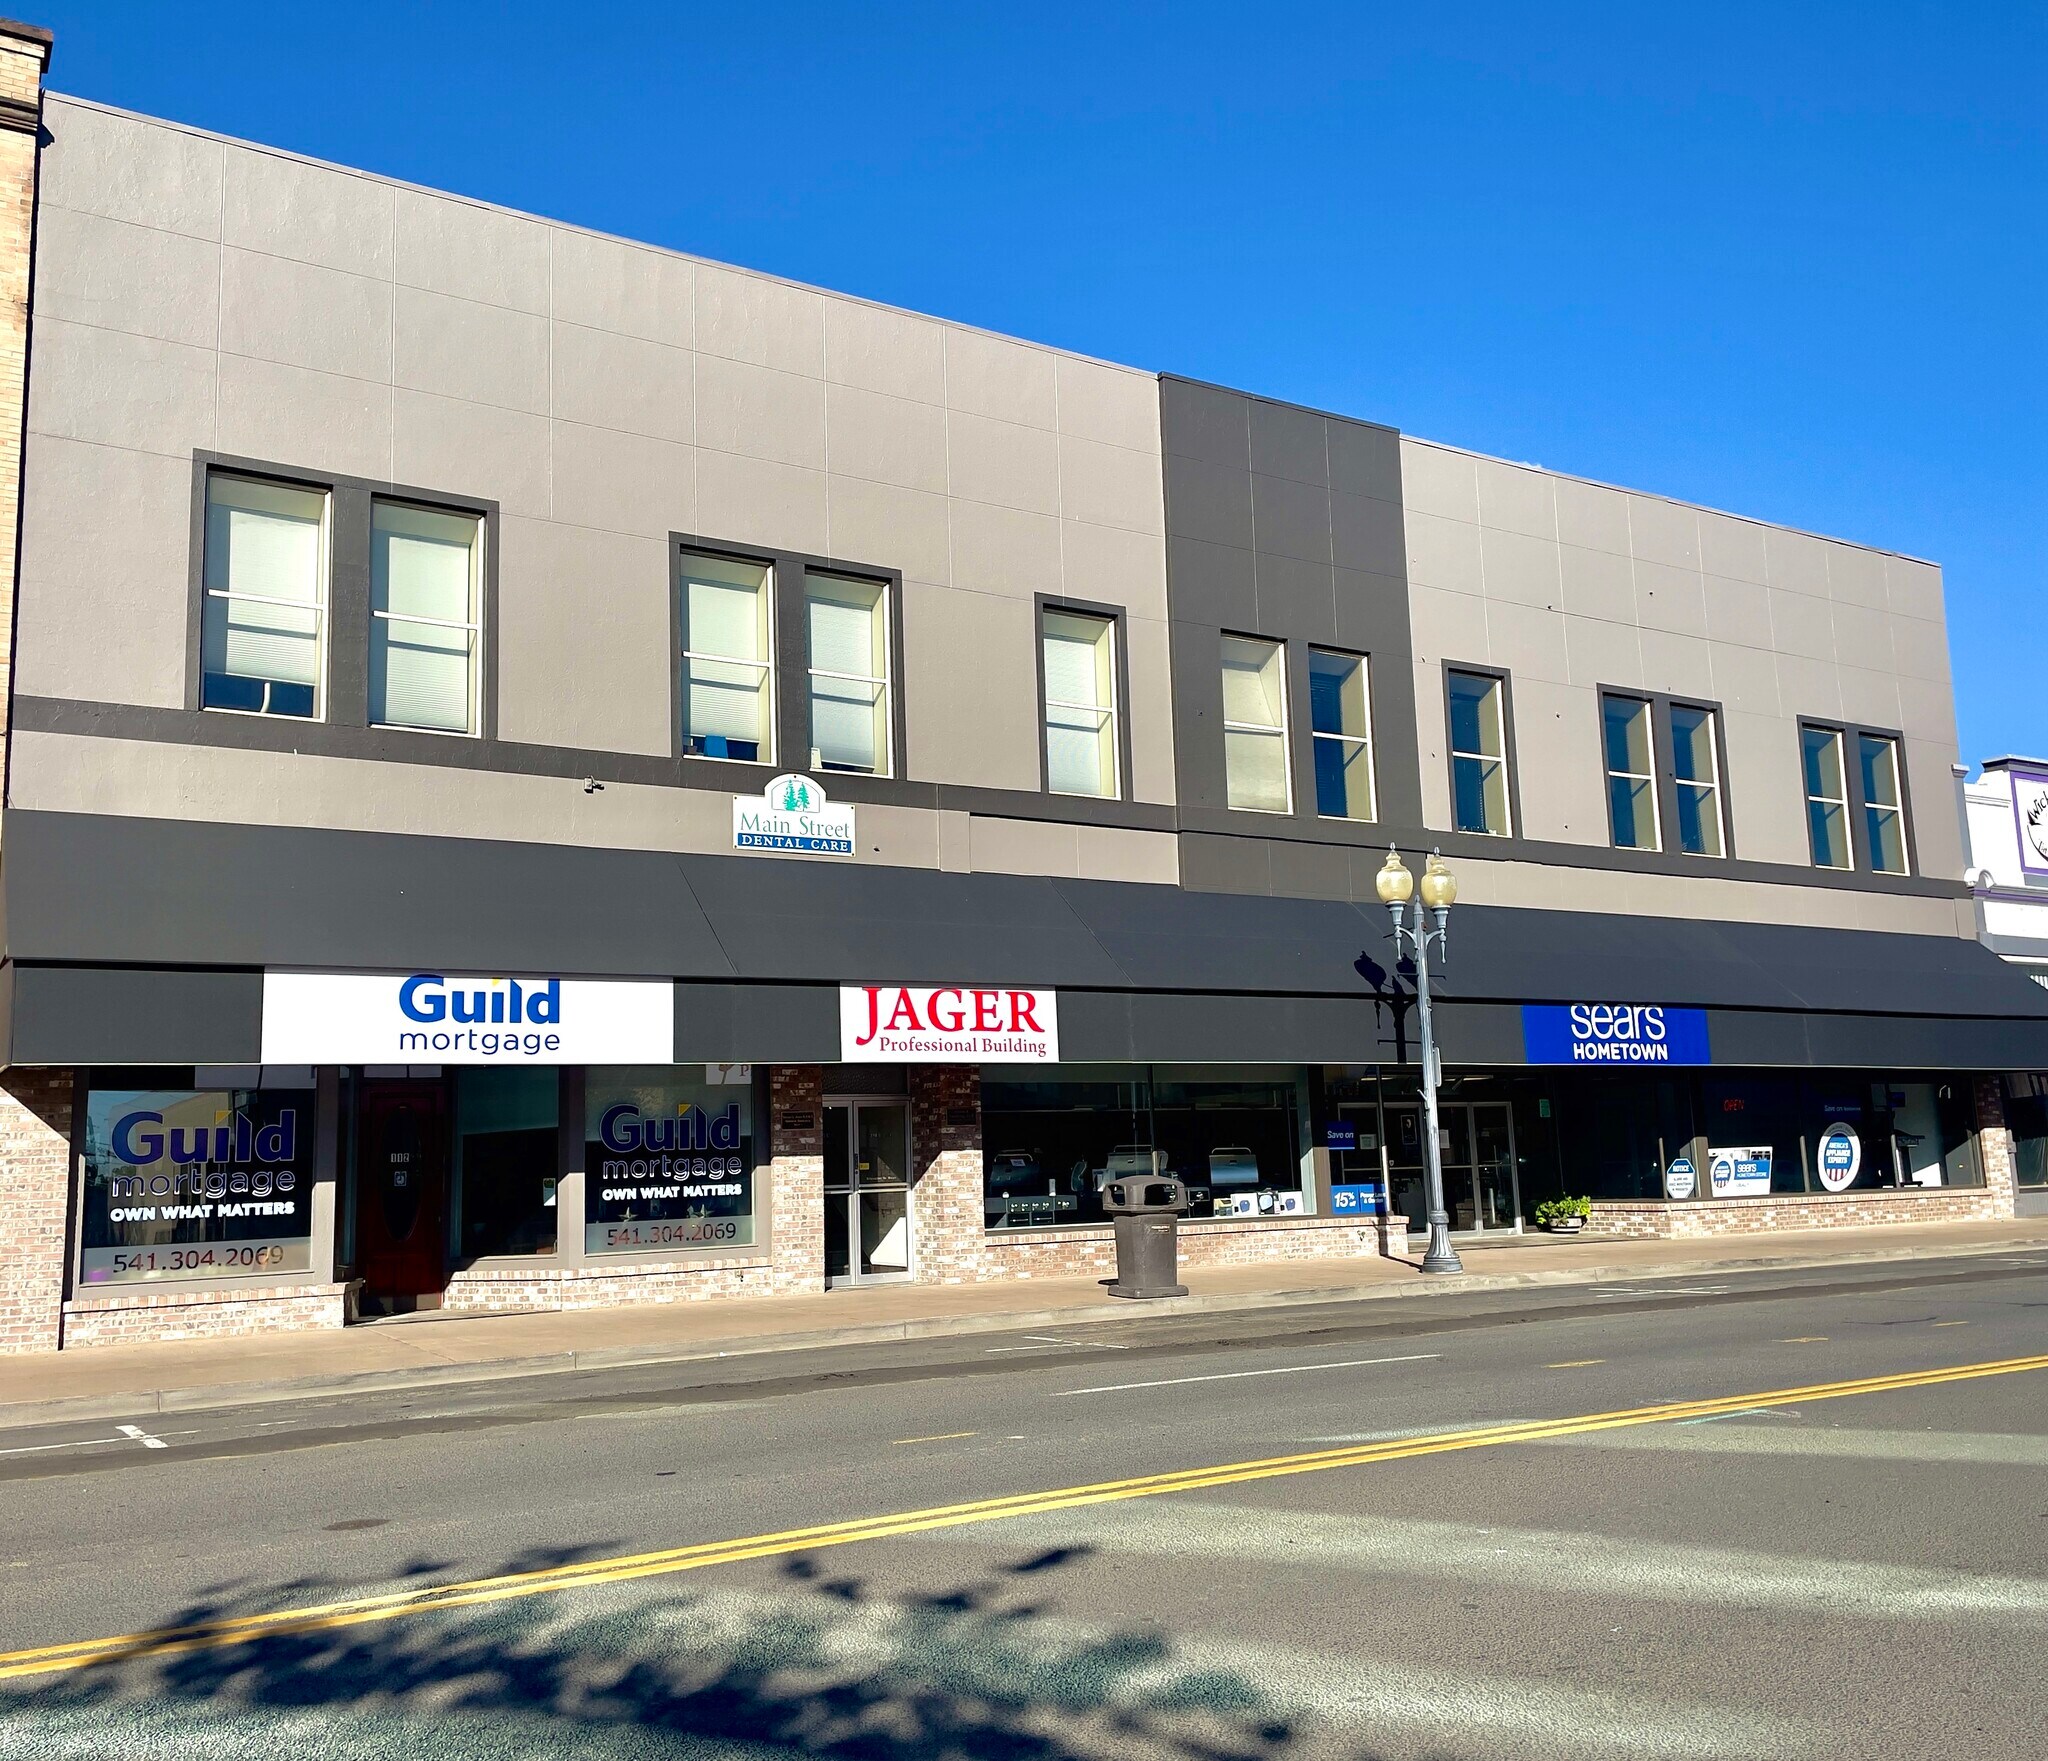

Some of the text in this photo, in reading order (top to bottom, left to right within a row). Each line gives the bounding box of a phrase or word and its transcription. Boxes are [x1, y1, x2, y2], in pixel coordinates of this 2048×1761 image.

[740, 812, 850, 839] Main Street
[741, 834, 848, 852] DENTAL CARE
[399, 974, 560, 1025] Guild
[856, 986, 1046, 1046] JAGER
[1570, 1003, 1666, 1040] sears
[400, 1028, 561, 1055] mortgage
[879, 1036, 1047, 1057] Professional Building
[1573, 1042, 1669, 1061] HOMETOWN
[111, 1109, 296, 1165] Guild
[600, 1103, 741, 1152] Guild
[1327, 1130, 1344, 1139] Save
[602, 1155, 742, 1181] mortgage
[1737, 1163, 1757, 1173] sears
[111, 1169, 296, 1199] mortgage
[602, 1183, 743, 1201] OWN WHAT MATTERS
[110, 1201, 295, 1222] OWN WHAT MATTERS
[607, 1222, 736, 1246] 541.304.2069
[113, 1245, 284, 1273] 541.304.2069
